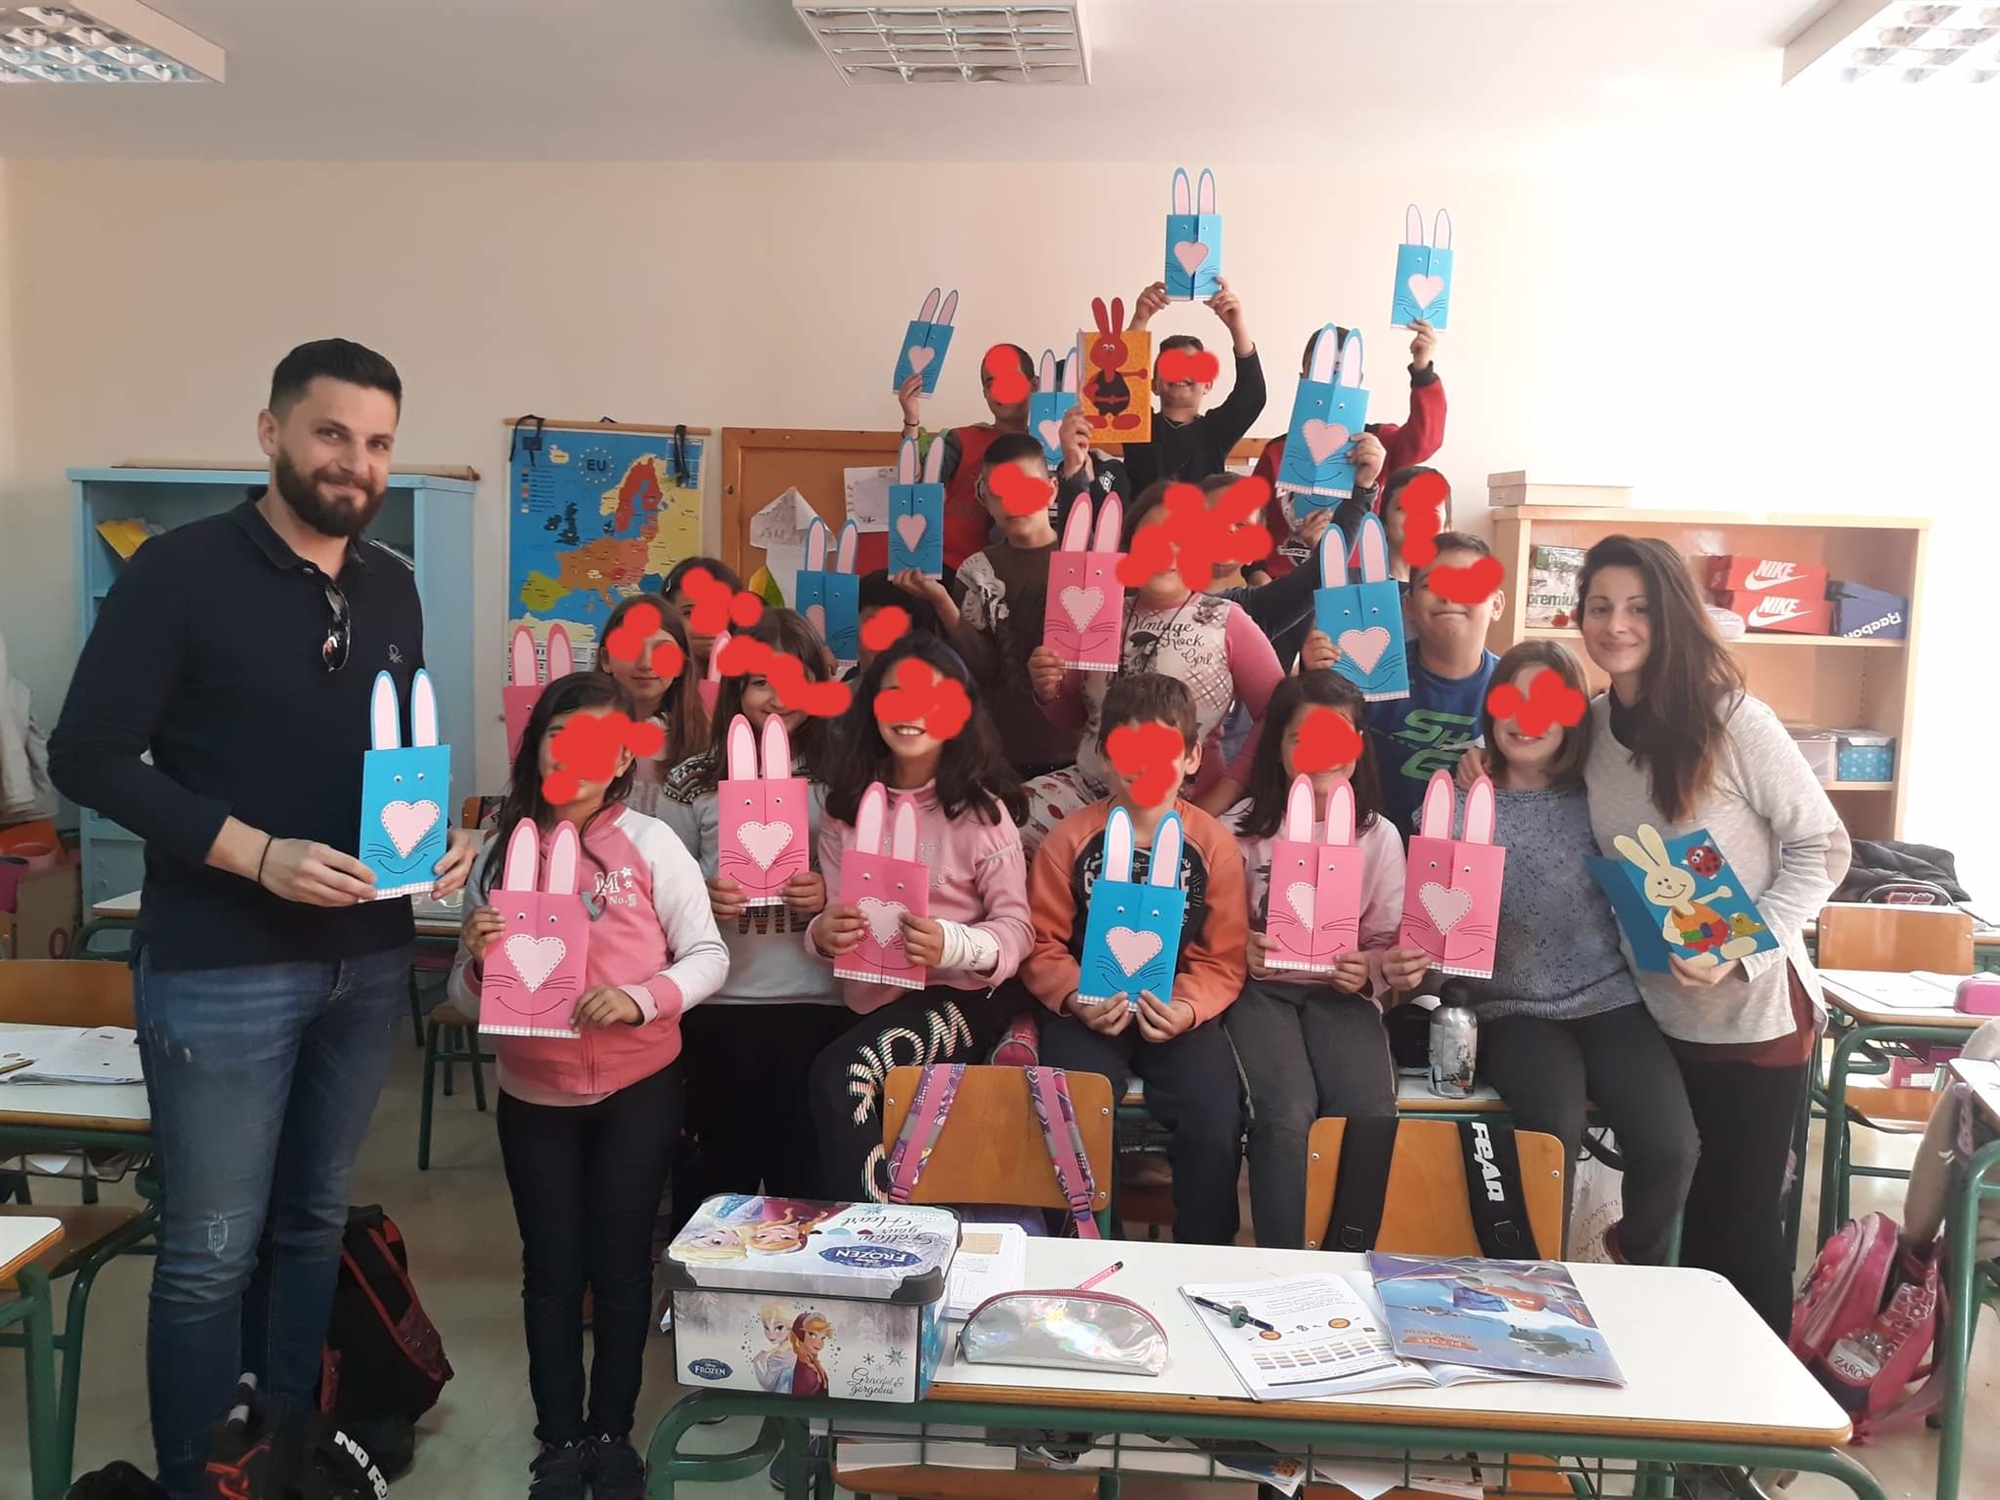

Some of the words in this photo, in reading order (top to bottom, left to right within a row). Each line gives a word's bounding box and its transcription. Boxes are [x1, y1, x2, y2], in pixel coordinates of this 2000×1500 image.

[587, 459, 606, 471] EU
[1754, 559, 1797, 579] NIKE
[1526, 592, 1578, 607] premiu
[1758, 595, 1801, 615] NIKE
[1129, 614, 1194, 637] Vintage
[1160, 632, 1204, 651] Rock
[1181, 648, 1213, 668] Girl
[841, 1215, 911, 1227] Heart
[881, 1224, 922, 1235] your
[859, 1232, 942, 1244] Follow
[835, 1249, 907, 1262] FROZEN
[694, 1365, 726, 1375] FROZEN
[850, 1385, 894, 1398] gorgeous
[334, 1430, 370, 1468] NO
[366, 1464, 391, 1500] Fe
